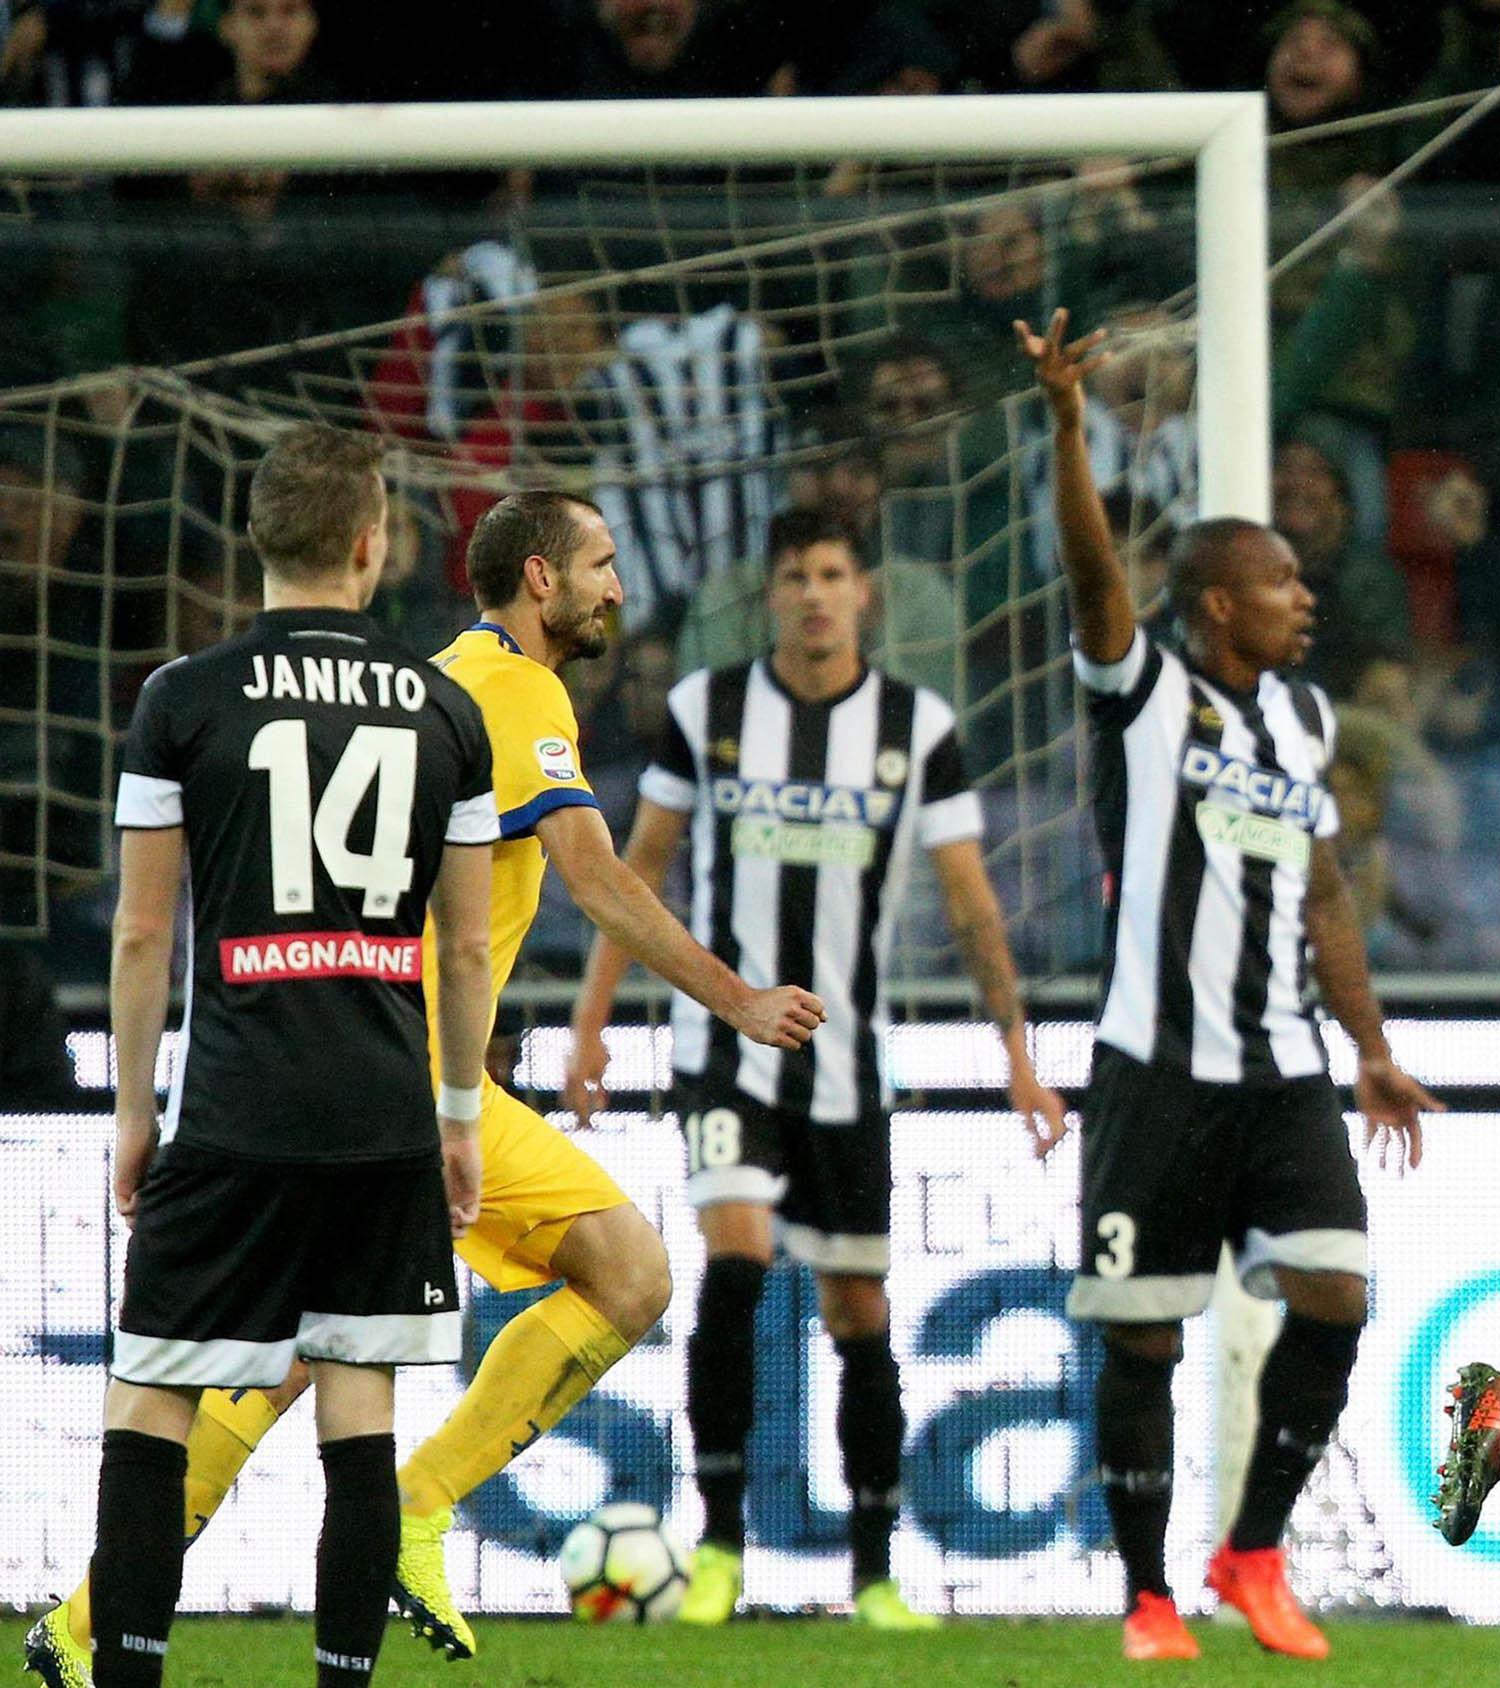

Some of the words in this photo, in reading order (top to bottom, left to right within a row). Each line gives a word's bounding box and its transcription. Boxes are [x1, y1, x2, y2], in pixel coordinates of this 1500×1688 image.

[242, 654, 427, 712] JANKTO
[713, 778, 860, 821] DACIA
[1181, 746, 1312, 819] DACIA
[248, 718, 418, 919] 14
[684, 1107, 742, 1174] 18
[1095, 1210, 1136, 1281] 3
